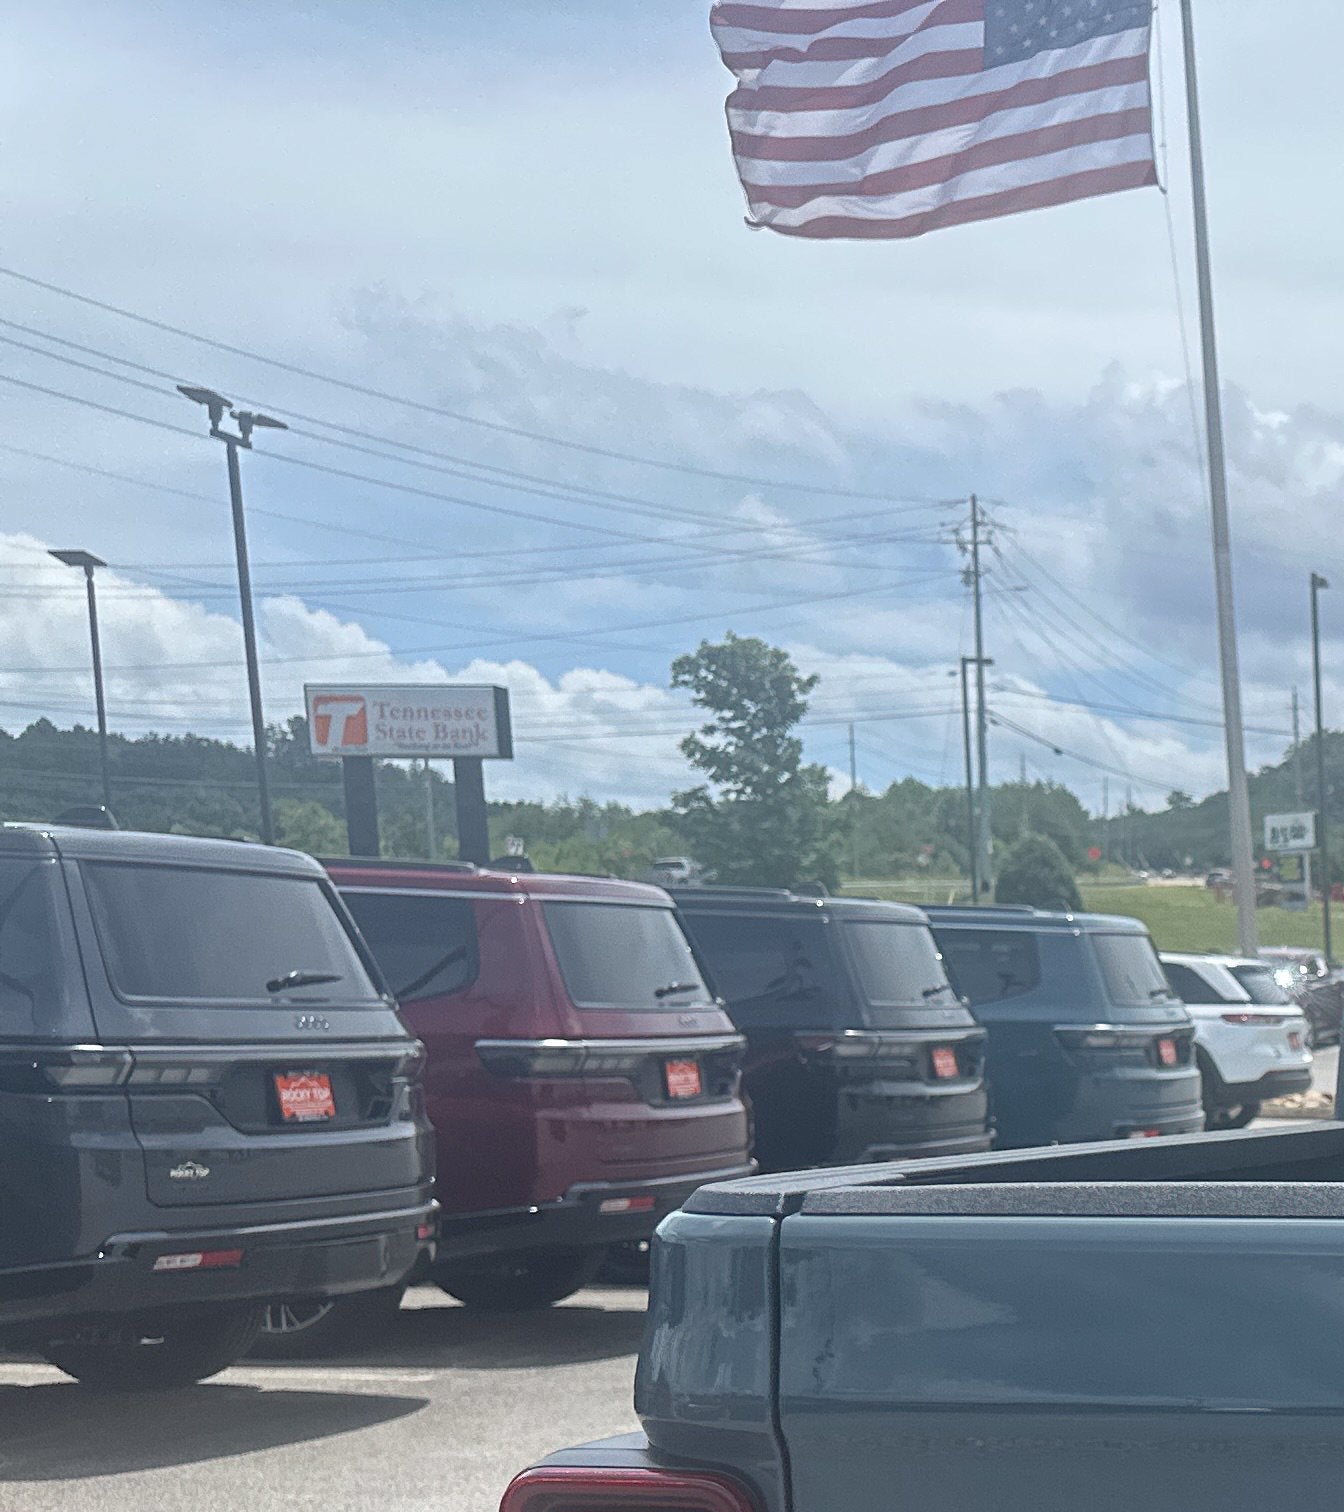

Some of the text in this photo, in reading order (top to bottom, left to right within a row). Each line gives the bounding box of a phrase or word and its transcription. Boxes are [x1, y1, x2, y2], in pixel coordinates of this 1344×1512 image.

[374, 702, 490, 721] Tennessee
[375, 722, 489, 742] State Bank
